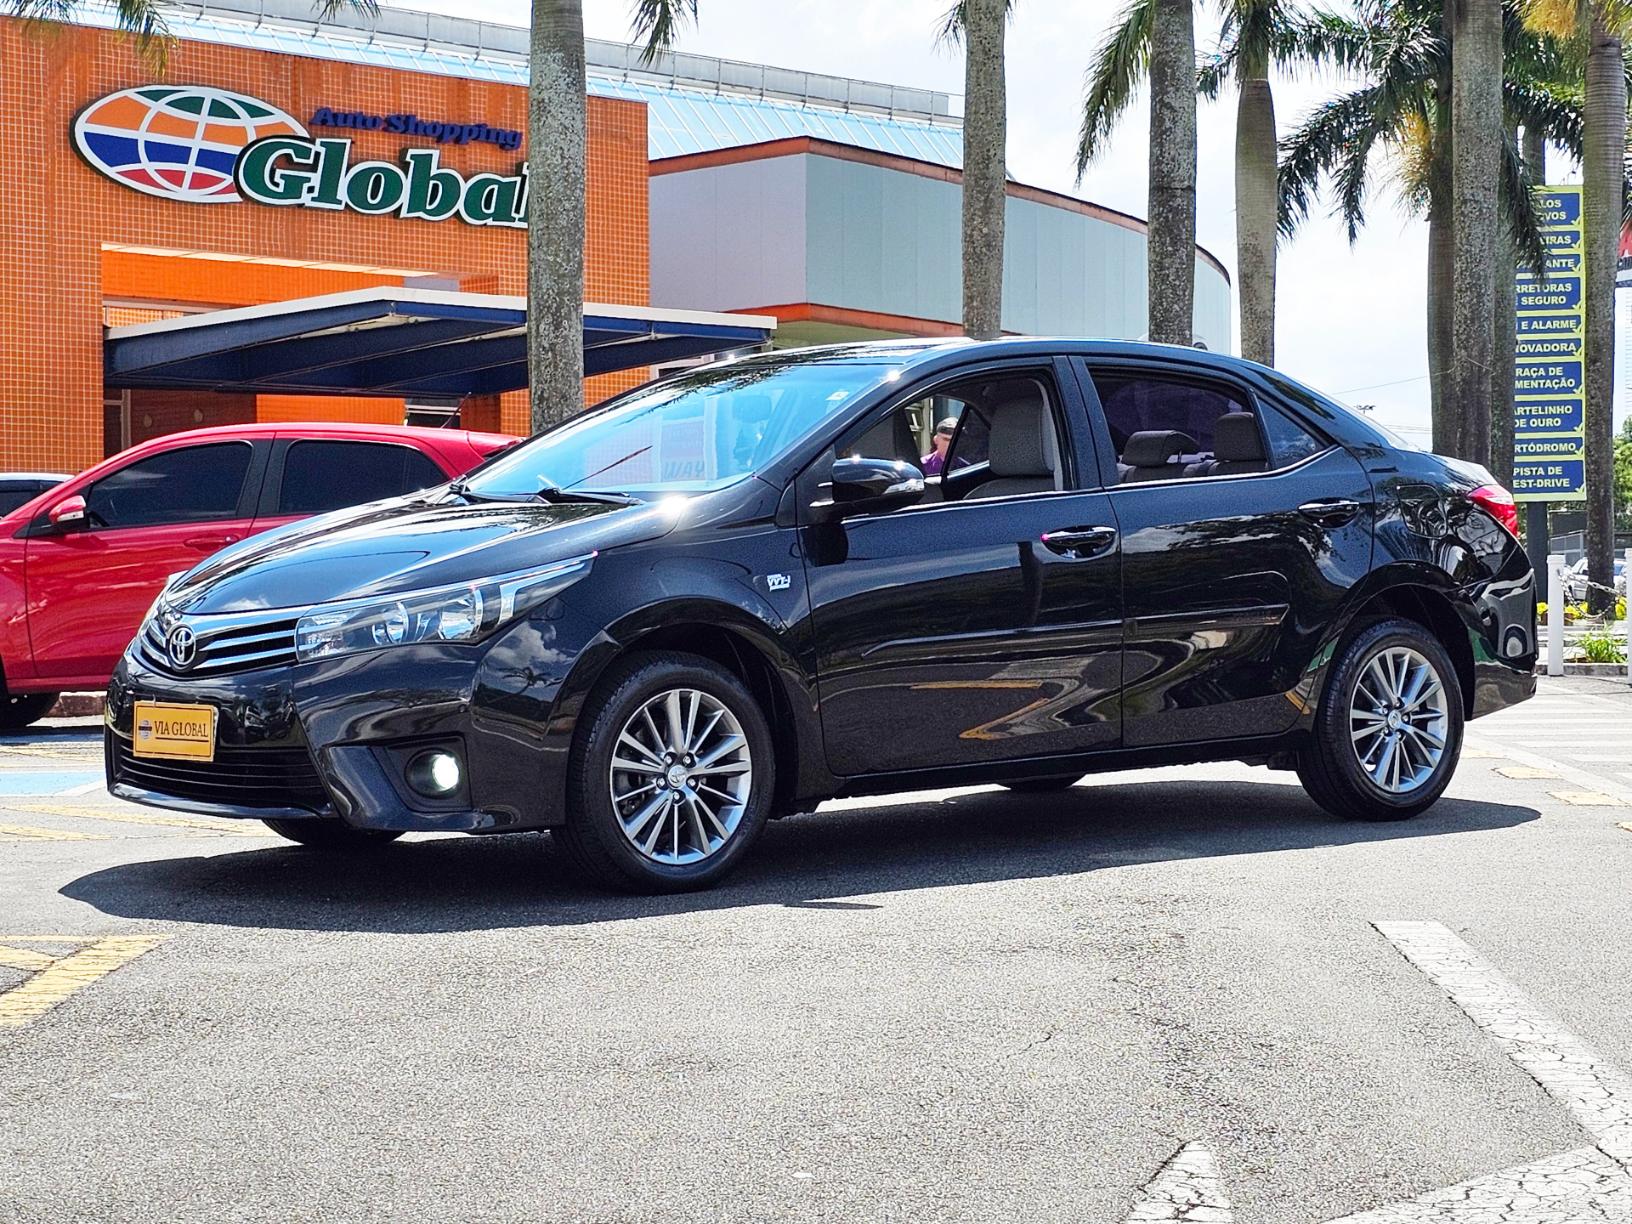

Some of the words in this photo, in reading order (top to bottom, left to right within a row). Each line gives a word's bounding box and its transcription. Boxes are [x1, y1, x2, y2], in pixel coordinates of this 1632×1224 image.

[309, 107, 382, 129] Auto
[382, 114, 523, 150] Shopping
[1521, 295, 1567, 305] SEGURO
[1521, 321, 1529, 330] E
[1531, 319, 1577, 330] ALARME
[1548, 366, 1564, 376] DE
[1529, 417, 1561, 427] OURO
[1513, 466, 1545, 476] PISTA
[1547, 466, 1563, 475] DE
[154, 720, 170, 735] VIA
[171, 721, 209, 738] GLOBAL
